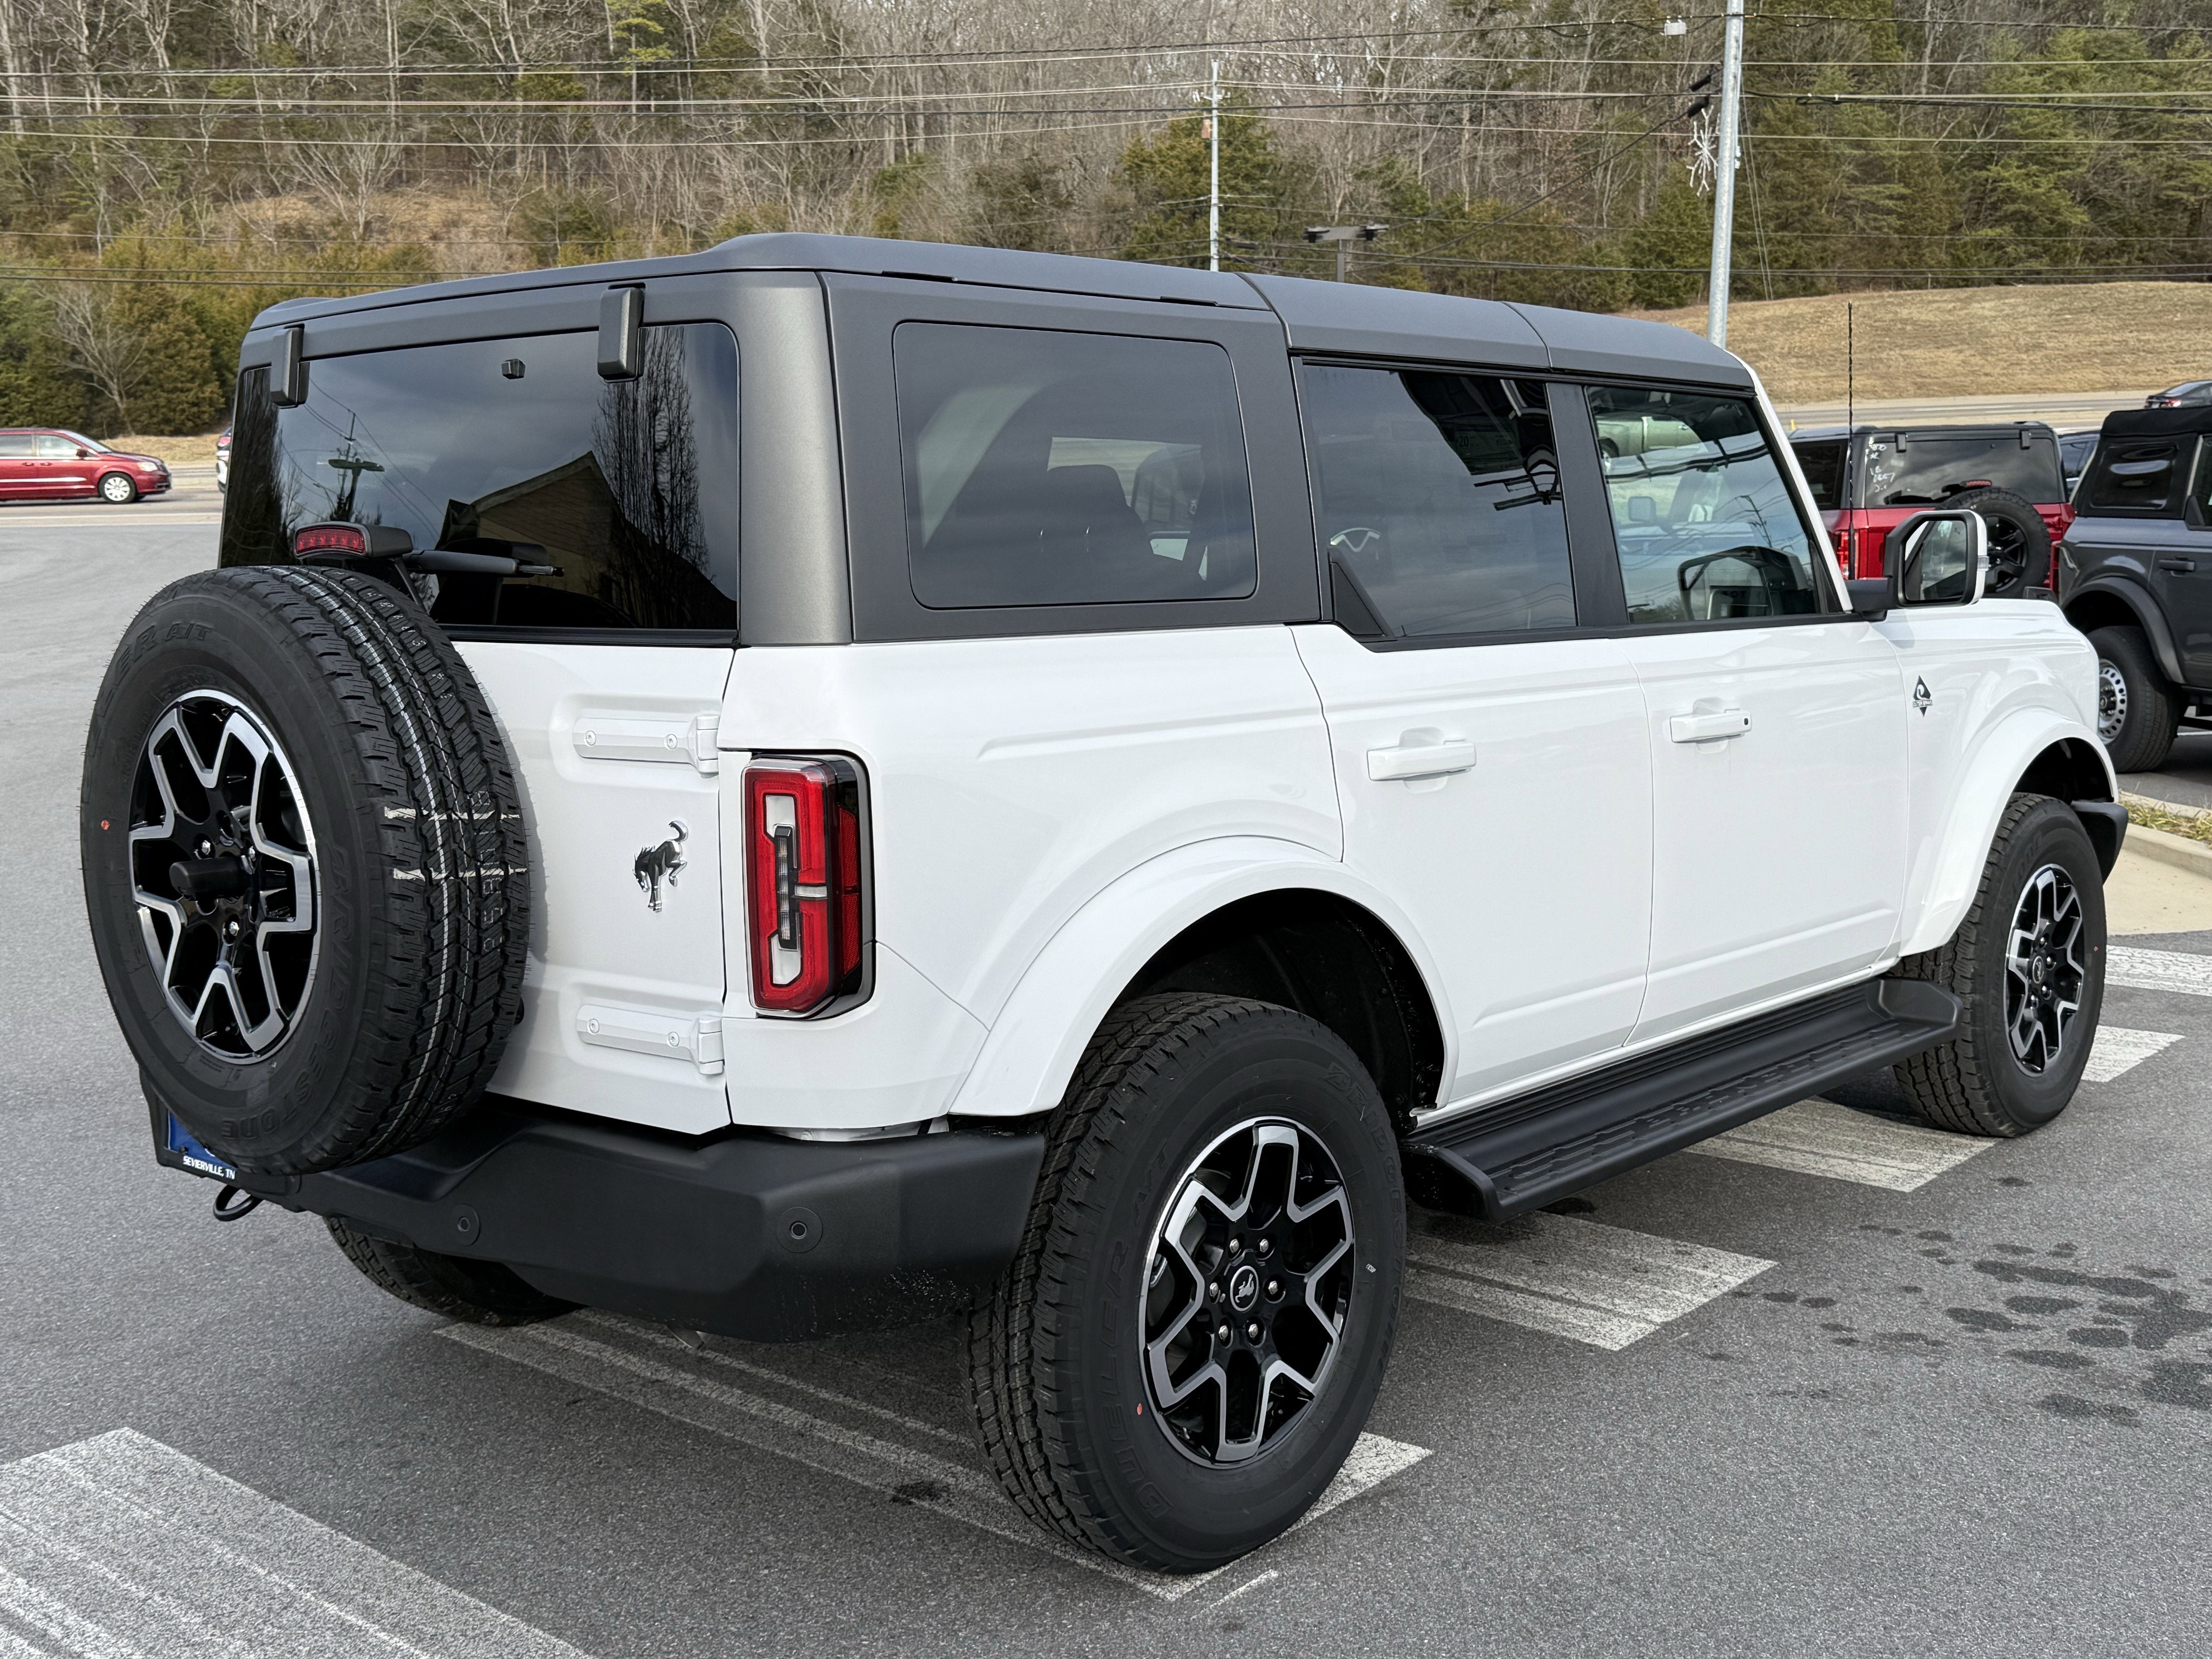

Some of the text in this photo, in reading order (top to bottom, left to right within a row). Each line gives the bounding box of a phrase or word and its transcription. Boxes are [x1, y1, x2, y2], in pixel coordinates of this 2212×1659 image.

[165, 622, 213, 642] A/T
[183, 1155, 236, 1180] SEVIERVILLE, TN
[1099, 1240, 1173, 1519] DUELER
